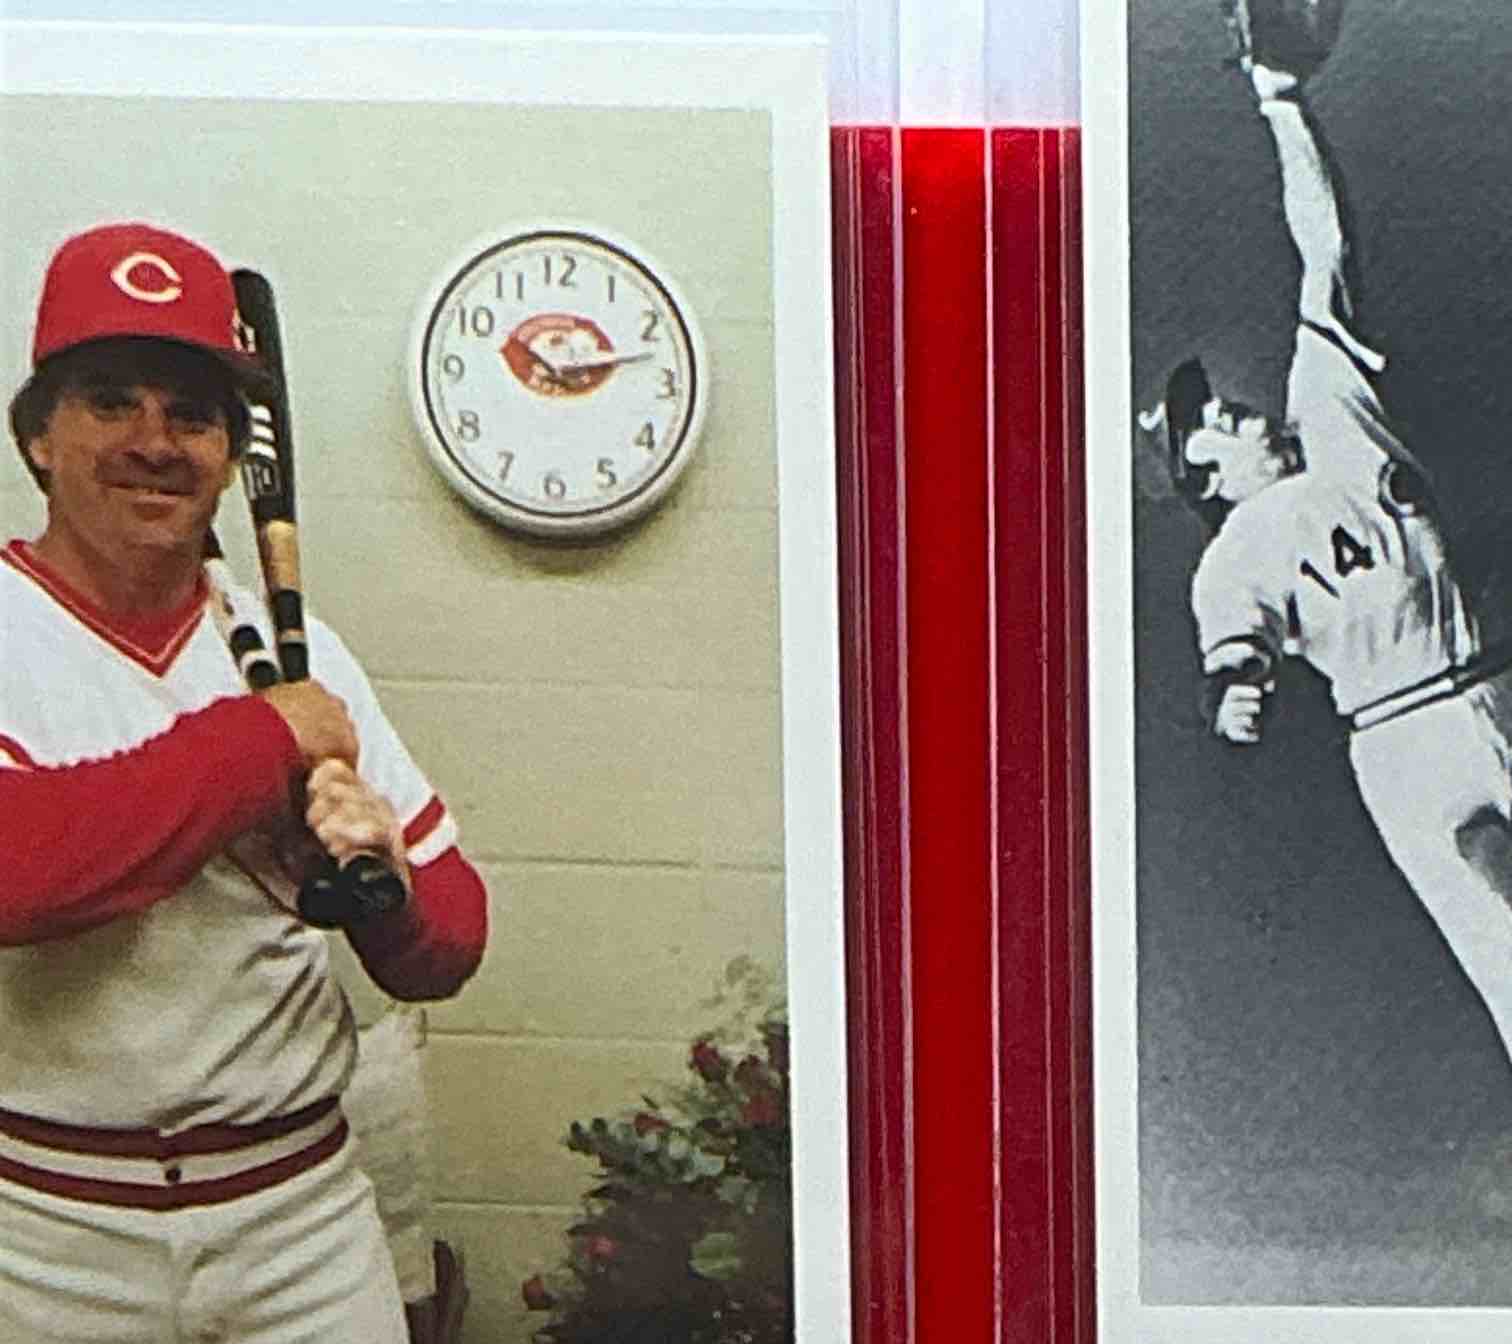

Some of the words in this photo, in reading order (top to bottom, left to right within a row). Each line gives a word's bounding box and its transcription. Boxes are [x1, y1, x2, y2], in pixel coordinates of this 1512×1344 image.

[110, 252, 184, 303] C
[495, 271, 524, 301] 11
[543, 255, 576, 287] 12
[607, 275, 616, 302] 1
[453, 304, 495, 337] 10
[641, 310, 659, 342] 2
[443, 354, 465, 382] 9
[657, 367, 677, 399] 3
[457, 410, 481, 442] 8
[635, 421, 655, 450] 4
[497, 450, 514, 481] 7
[596, 458, 617, 488] 5
[543, 473, 567, 498] 6
[1299, 524, 1376, 600] 14
